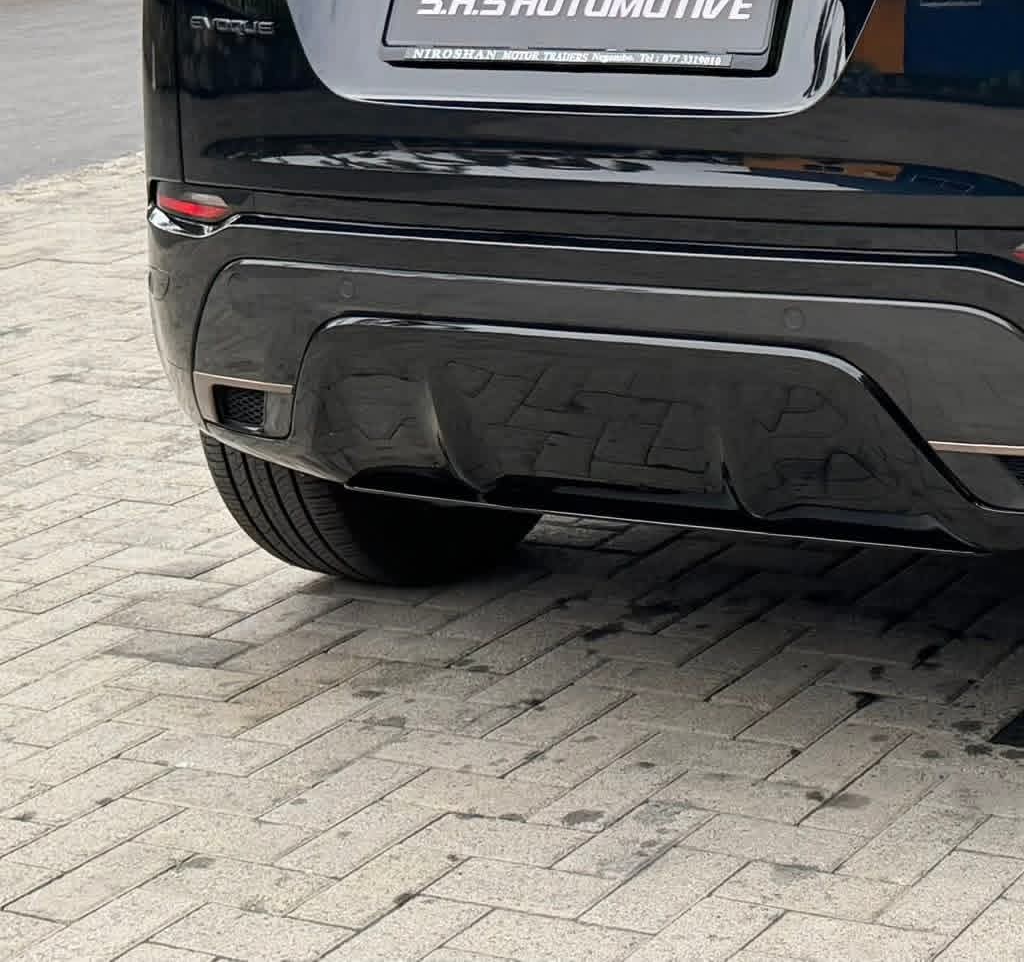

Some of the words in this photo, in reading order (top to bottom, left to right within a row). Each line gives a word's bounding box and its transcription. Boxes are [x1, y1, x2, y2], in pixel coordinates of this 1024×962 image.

[190, 15, 275, 36] EVOQUE
[413, 48, 497, 60] NIROSHAN
[502, 50, 540, 61] MOTOR
[543, 51, 588, 62] TRADERS
